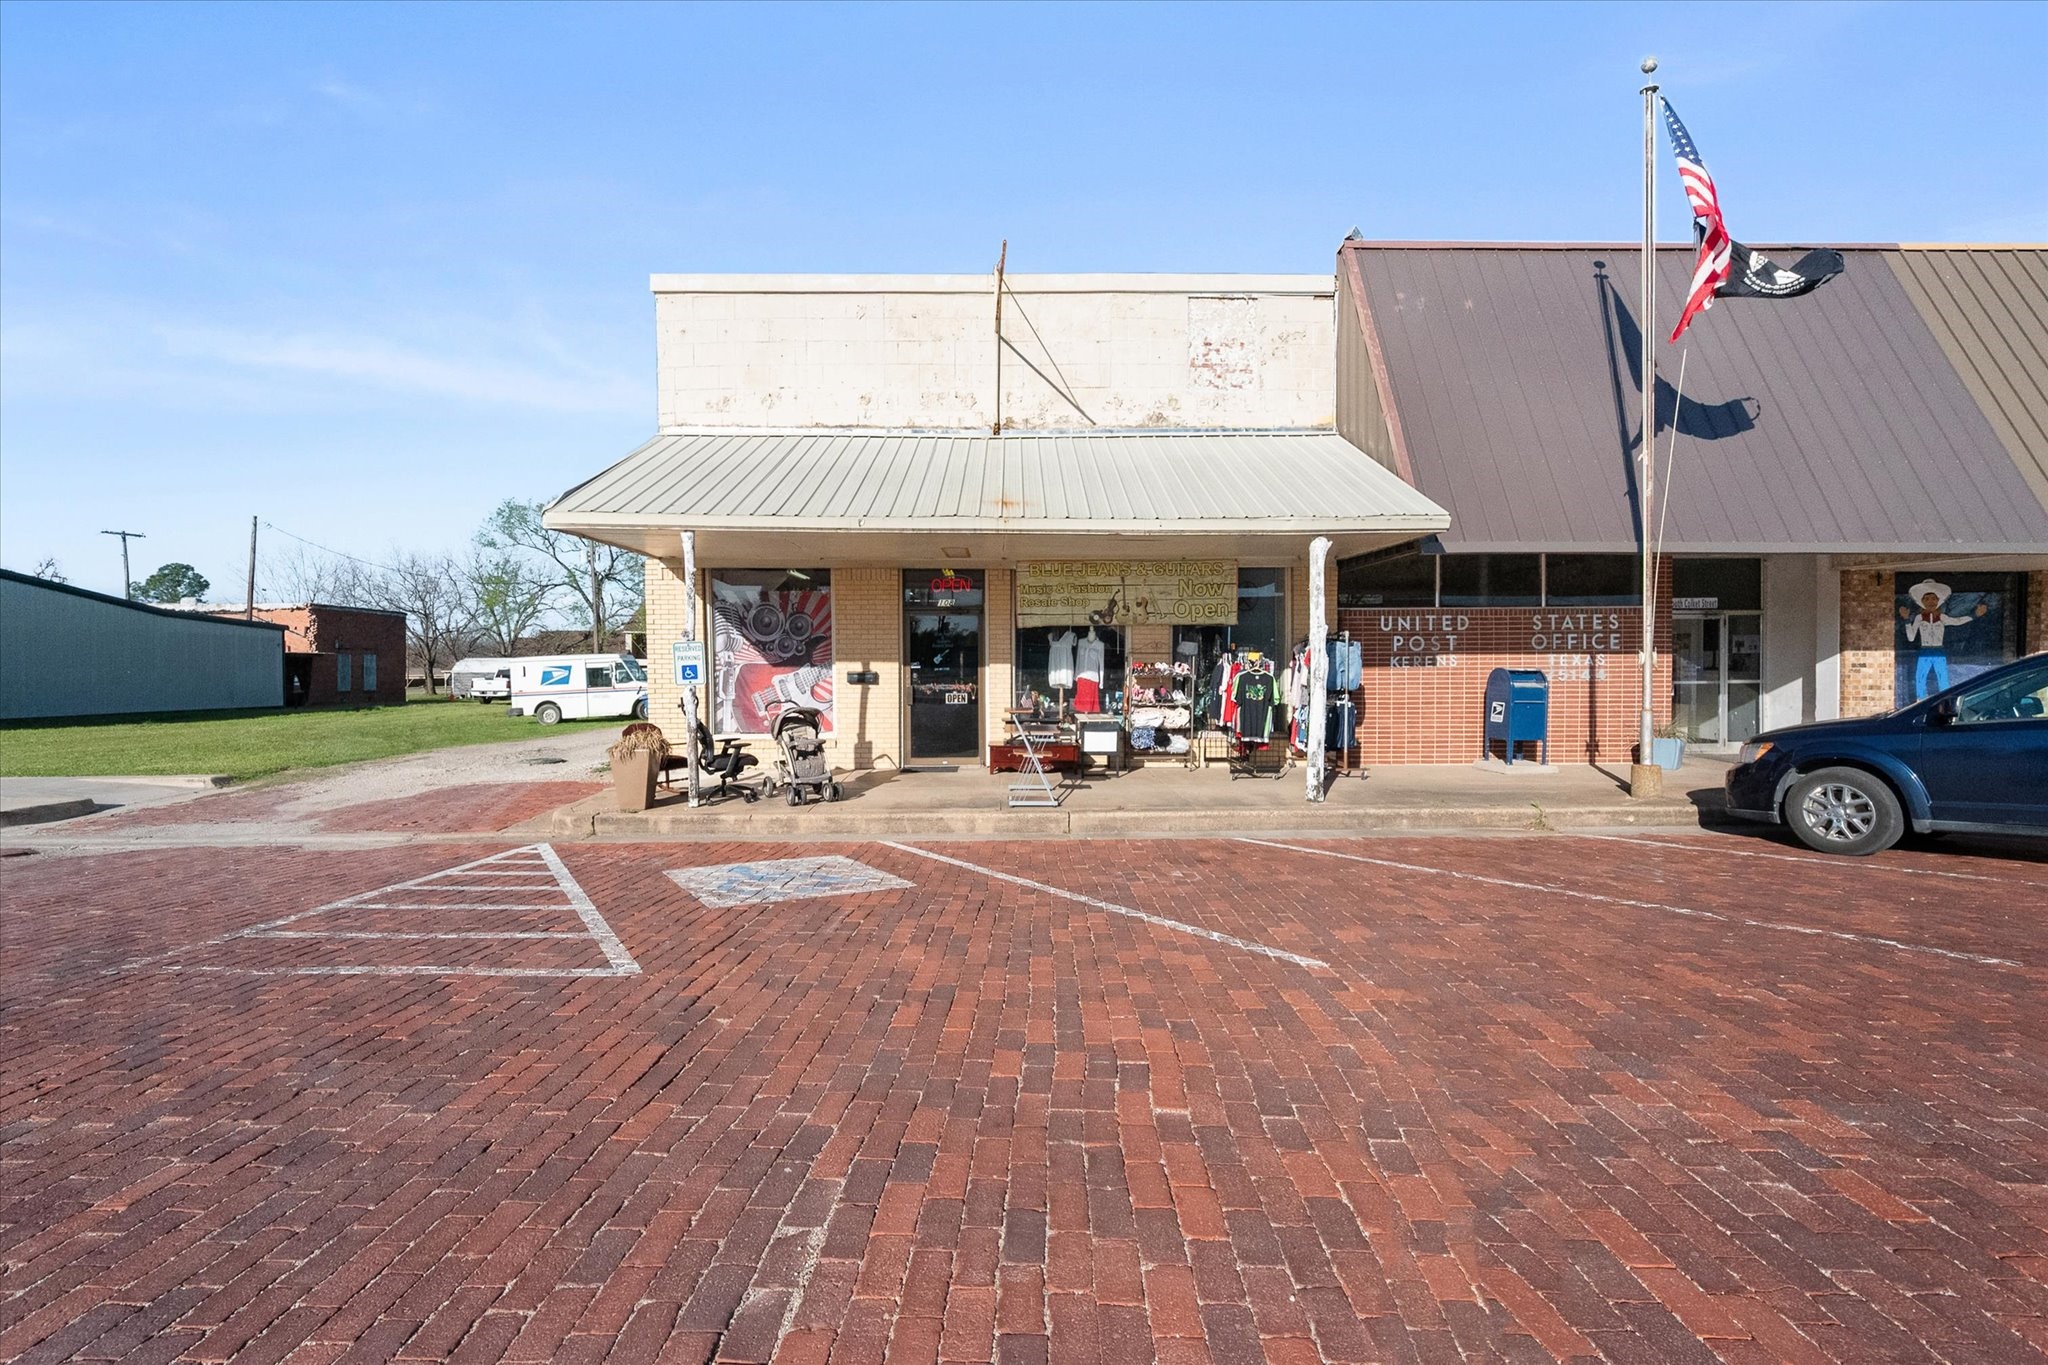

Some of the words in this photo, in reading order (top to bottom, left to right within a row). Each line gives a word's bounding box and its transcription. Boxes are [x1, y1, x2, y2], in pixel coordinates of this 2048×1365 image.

[1028, 563, 1073, 577] BLUE
[1077, 562, 1131, 577] JEANS
[1136, 562, 1149, 577] &
[1152, 562, 1224, 577] GUITARS
[931, 578, 971, 593] OPEN
[1020, 583, 1052, 595] Music
[1056, 583, 1065, 594] &
[1067, 582, 1113, 594] Fashion
[1177, 579, 1224, 597] Now
[1060, 595, 1091, 609] Shop
[1701, 599, 1717, 608] Street
[1173, 600, 1229, 622] Open
[1380, 615, 1470, 632] UNITED
[1532, 613, 1619, 631] STATES
[1393, 634, 1458, 652] POST
[1531, 633, 1621, 650] OFFICE
[677, 654, 701, 662] PARKING
[1390, 654, 1458, 669] KERENS
[1547, 653, 1606, 667] TEXAS
[947, 694, 967, 703] OPEN
